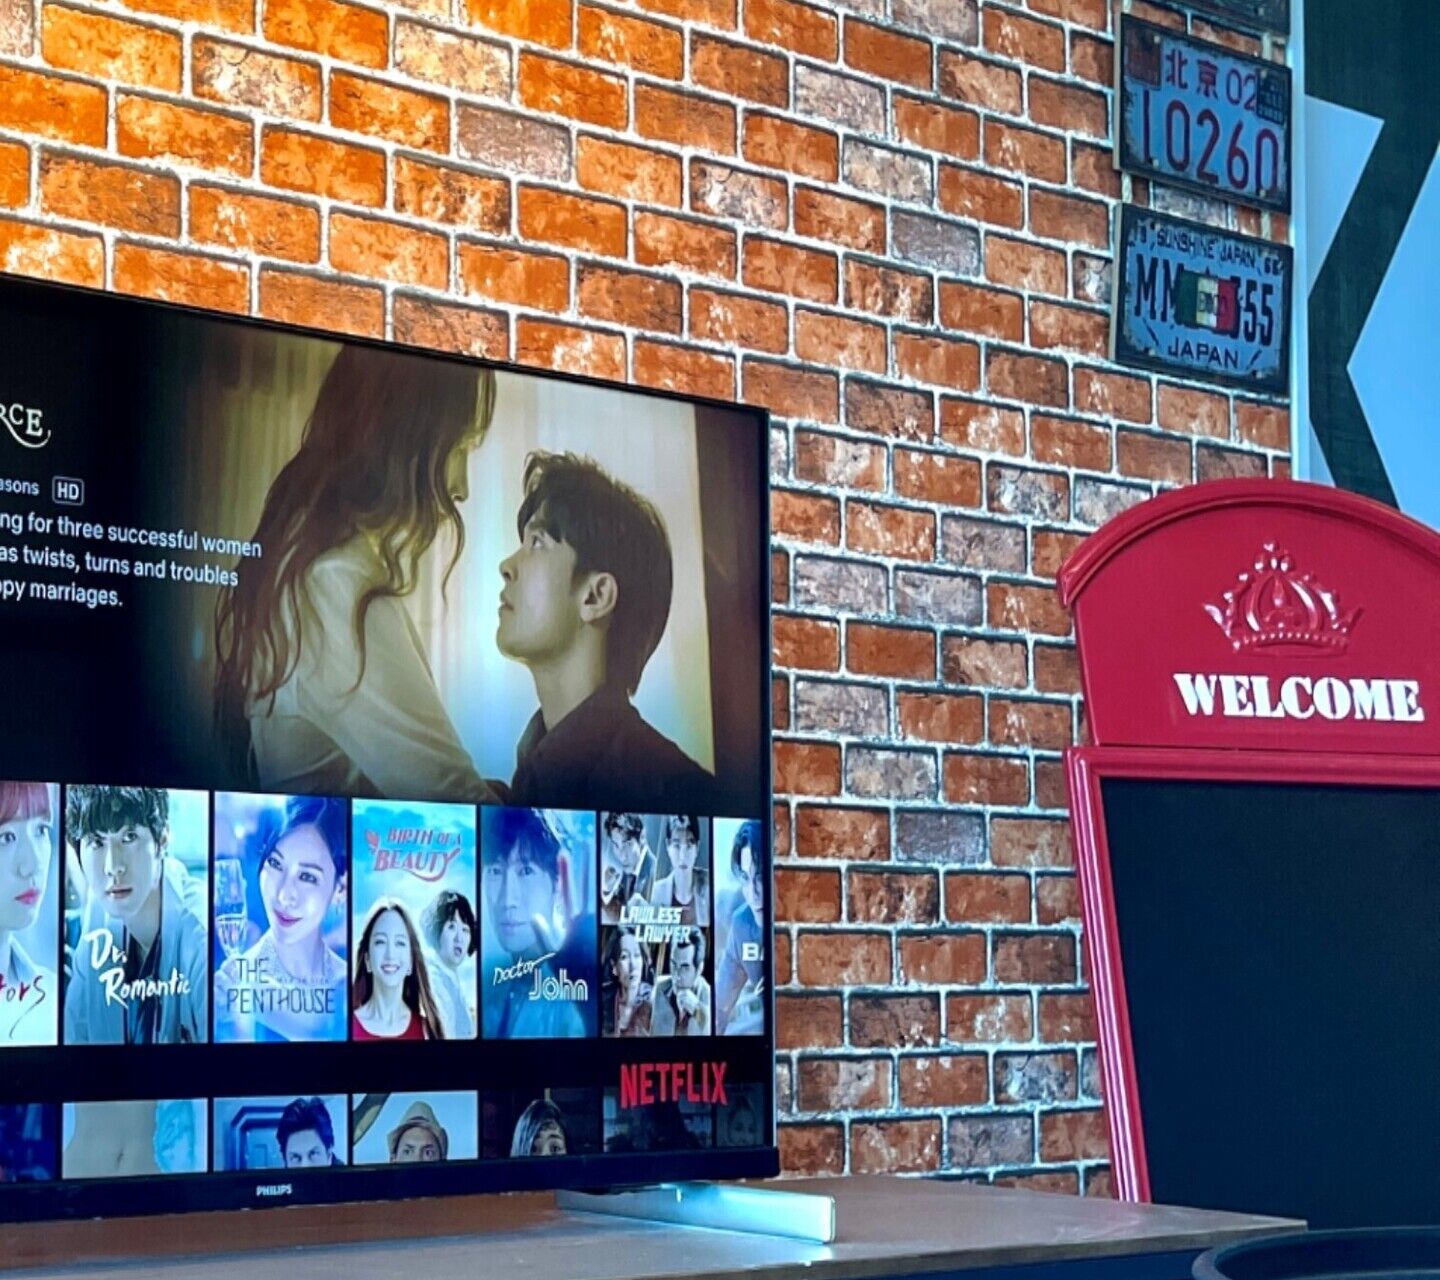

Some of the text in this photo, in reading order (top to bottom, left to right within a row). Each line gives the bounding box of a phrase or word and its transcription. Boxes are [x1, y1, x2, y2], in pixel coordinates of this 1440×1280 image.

[1165, 46, 1219, 100] 北京
[1167, 335, 1239, 370] JAPAN
[57, 481, 80, 501] HD
[27, 510, 54, 533] for
[57, 515, 104, 540] three
[107, 524, 198, 551] successful
[201, 534, 263, 558] women
[23, 544, 81, 574] twists,
[85, 552, 130, 576] turns
[133, 559, 167, 580] and
[170, 561, 239, 588] troubles
[29, 581, 124, 610] marriages.
[1172, 672, 1425, 722] WELCOME
[387, 826, 434, 846] BIRTH
[374, 848, 461, 882] BEAUTY
[620, 905, 683, 925] LAWLESS
[84, 926, 129, 970] Dr.
[635, 924, 692, 944] LAWYER
[235, 957, 271, 984] THE
[493, 952, 556, 986] Doctor
[528, 967, 589, 1002] John
[98, 967, 192, 1009] Romantic
[226, 987, 337, 1015] PENTHOUSE
[620, 1061, 729, 1110] NETFLIX
[256, 1184, 293, 1197] PHILIPS
